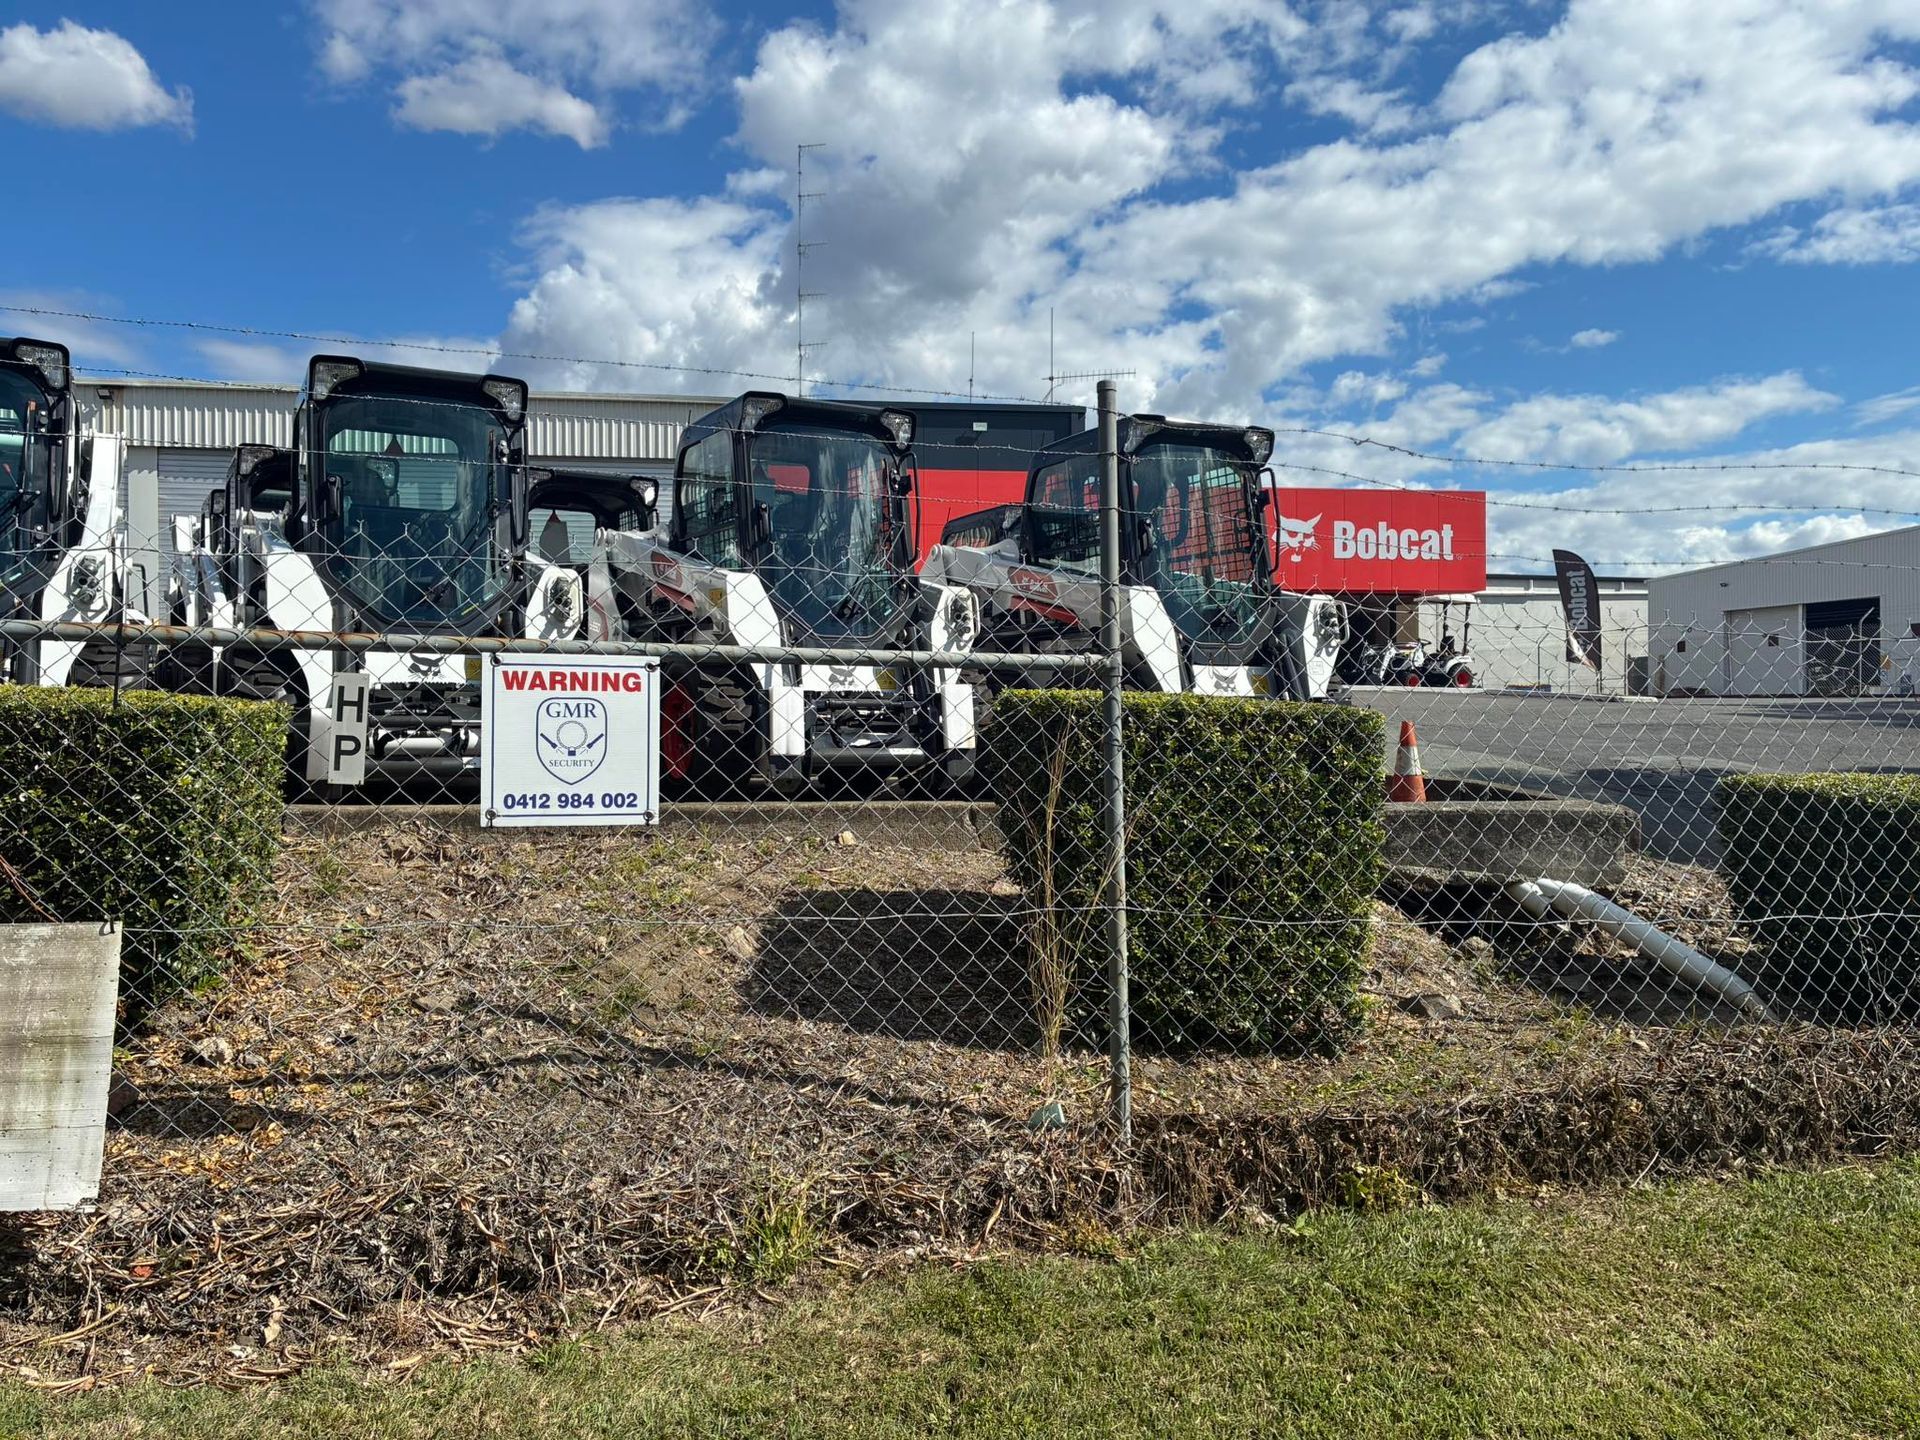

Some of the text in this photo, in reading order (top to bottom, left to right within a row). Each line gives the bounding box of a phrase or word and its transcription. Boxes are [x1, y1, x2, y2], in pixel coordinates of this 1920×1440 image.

[1333, 520, 1454, 561] Bobcat
[1566, 570, 1589, 630] Bobcat
[502, 670, 642, 693] WARNING
[546, 702, 598, 719] GMR
[549, 759, 595, 768] SECURITY
[503, 792, 638, 809] 0412 984 002
